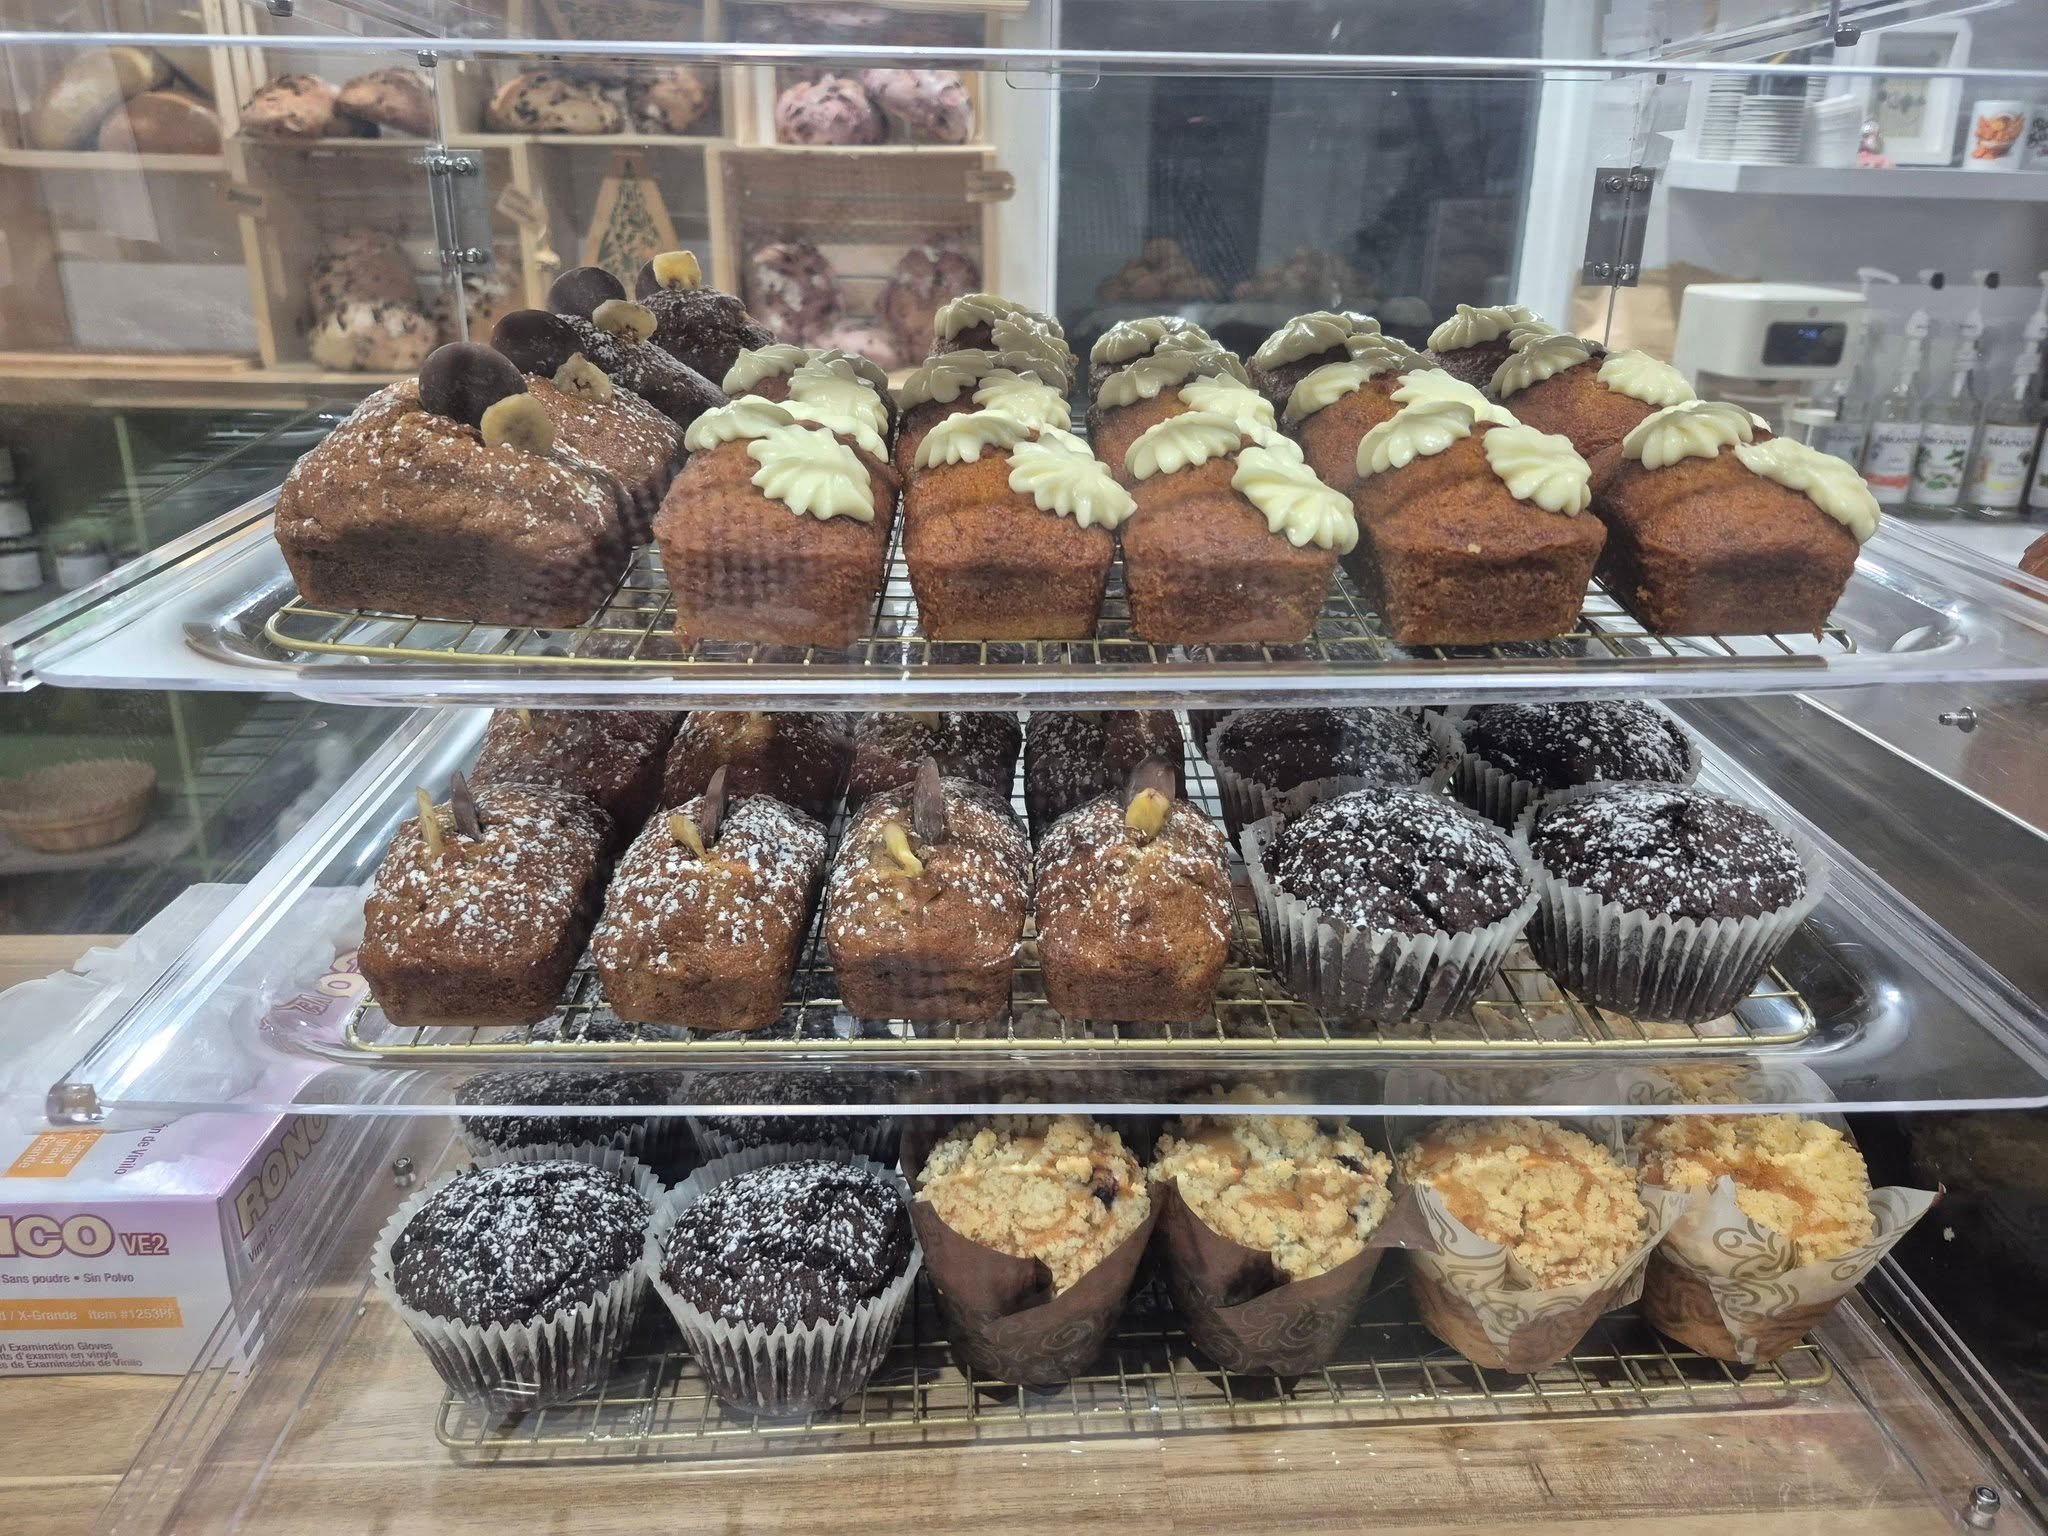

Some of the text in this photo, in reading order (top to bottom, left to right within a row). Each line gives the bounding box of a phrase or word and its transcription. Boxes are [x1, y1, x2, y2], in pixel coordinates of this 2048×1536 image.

[137, 1136, 156, 1147] de
[114, 1149, 149, 1175] Vinilo
[119, 1232, 170, 1256] VE2
[1, 1272, 135, 1285] Sans poudre Sin Polvo
[19, 1309, 78, 1321] X-Grande
[88, 1309, 117, 1320] Item
[9, 1341, 75, 1352] Examination
[78, 1341, 113, 1351] Gloves
[15, 1351, 68, 1361] d'examen
[71, 1352, 84, 1361] en
[87, 1350, 119, 1361] vinyle
[11, 1360, 25, 1369] de
[28, 1358, 95, 1369] Examinación
[97, 1358, 112, 1368] de
